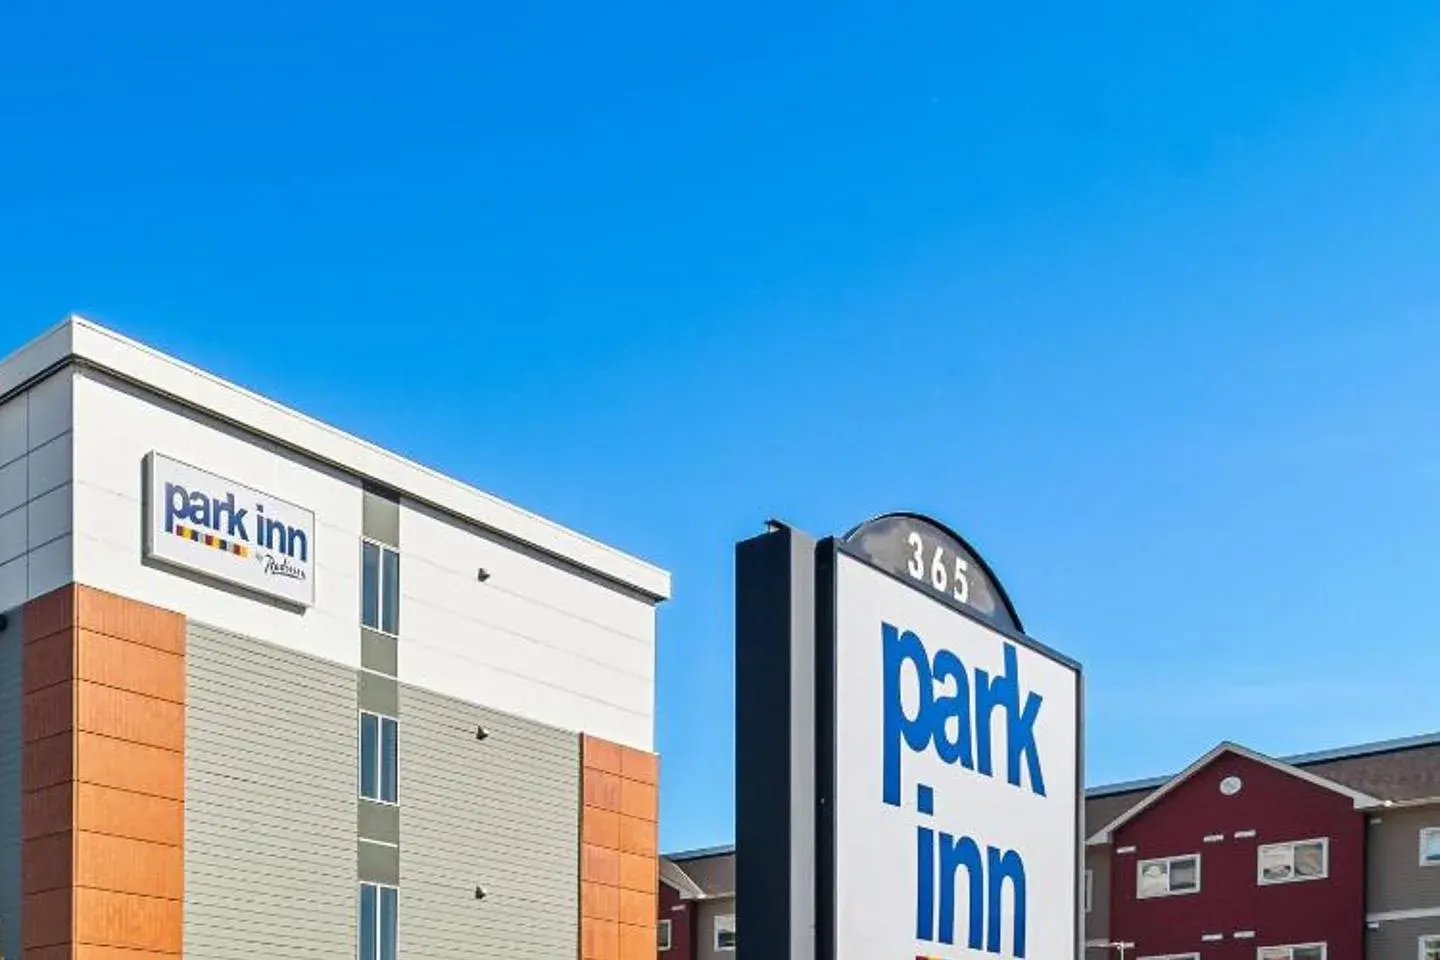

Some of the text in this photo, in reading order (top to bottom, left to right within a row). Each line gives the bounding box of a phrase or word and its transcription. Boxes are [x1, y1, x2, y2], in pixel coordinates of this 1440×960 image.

[165, 482, 307, 562] park inn
[908, 532, 969, 603] 365
[881, 620, 1047, 807] park
[916, 783, 1027, 960] inn
